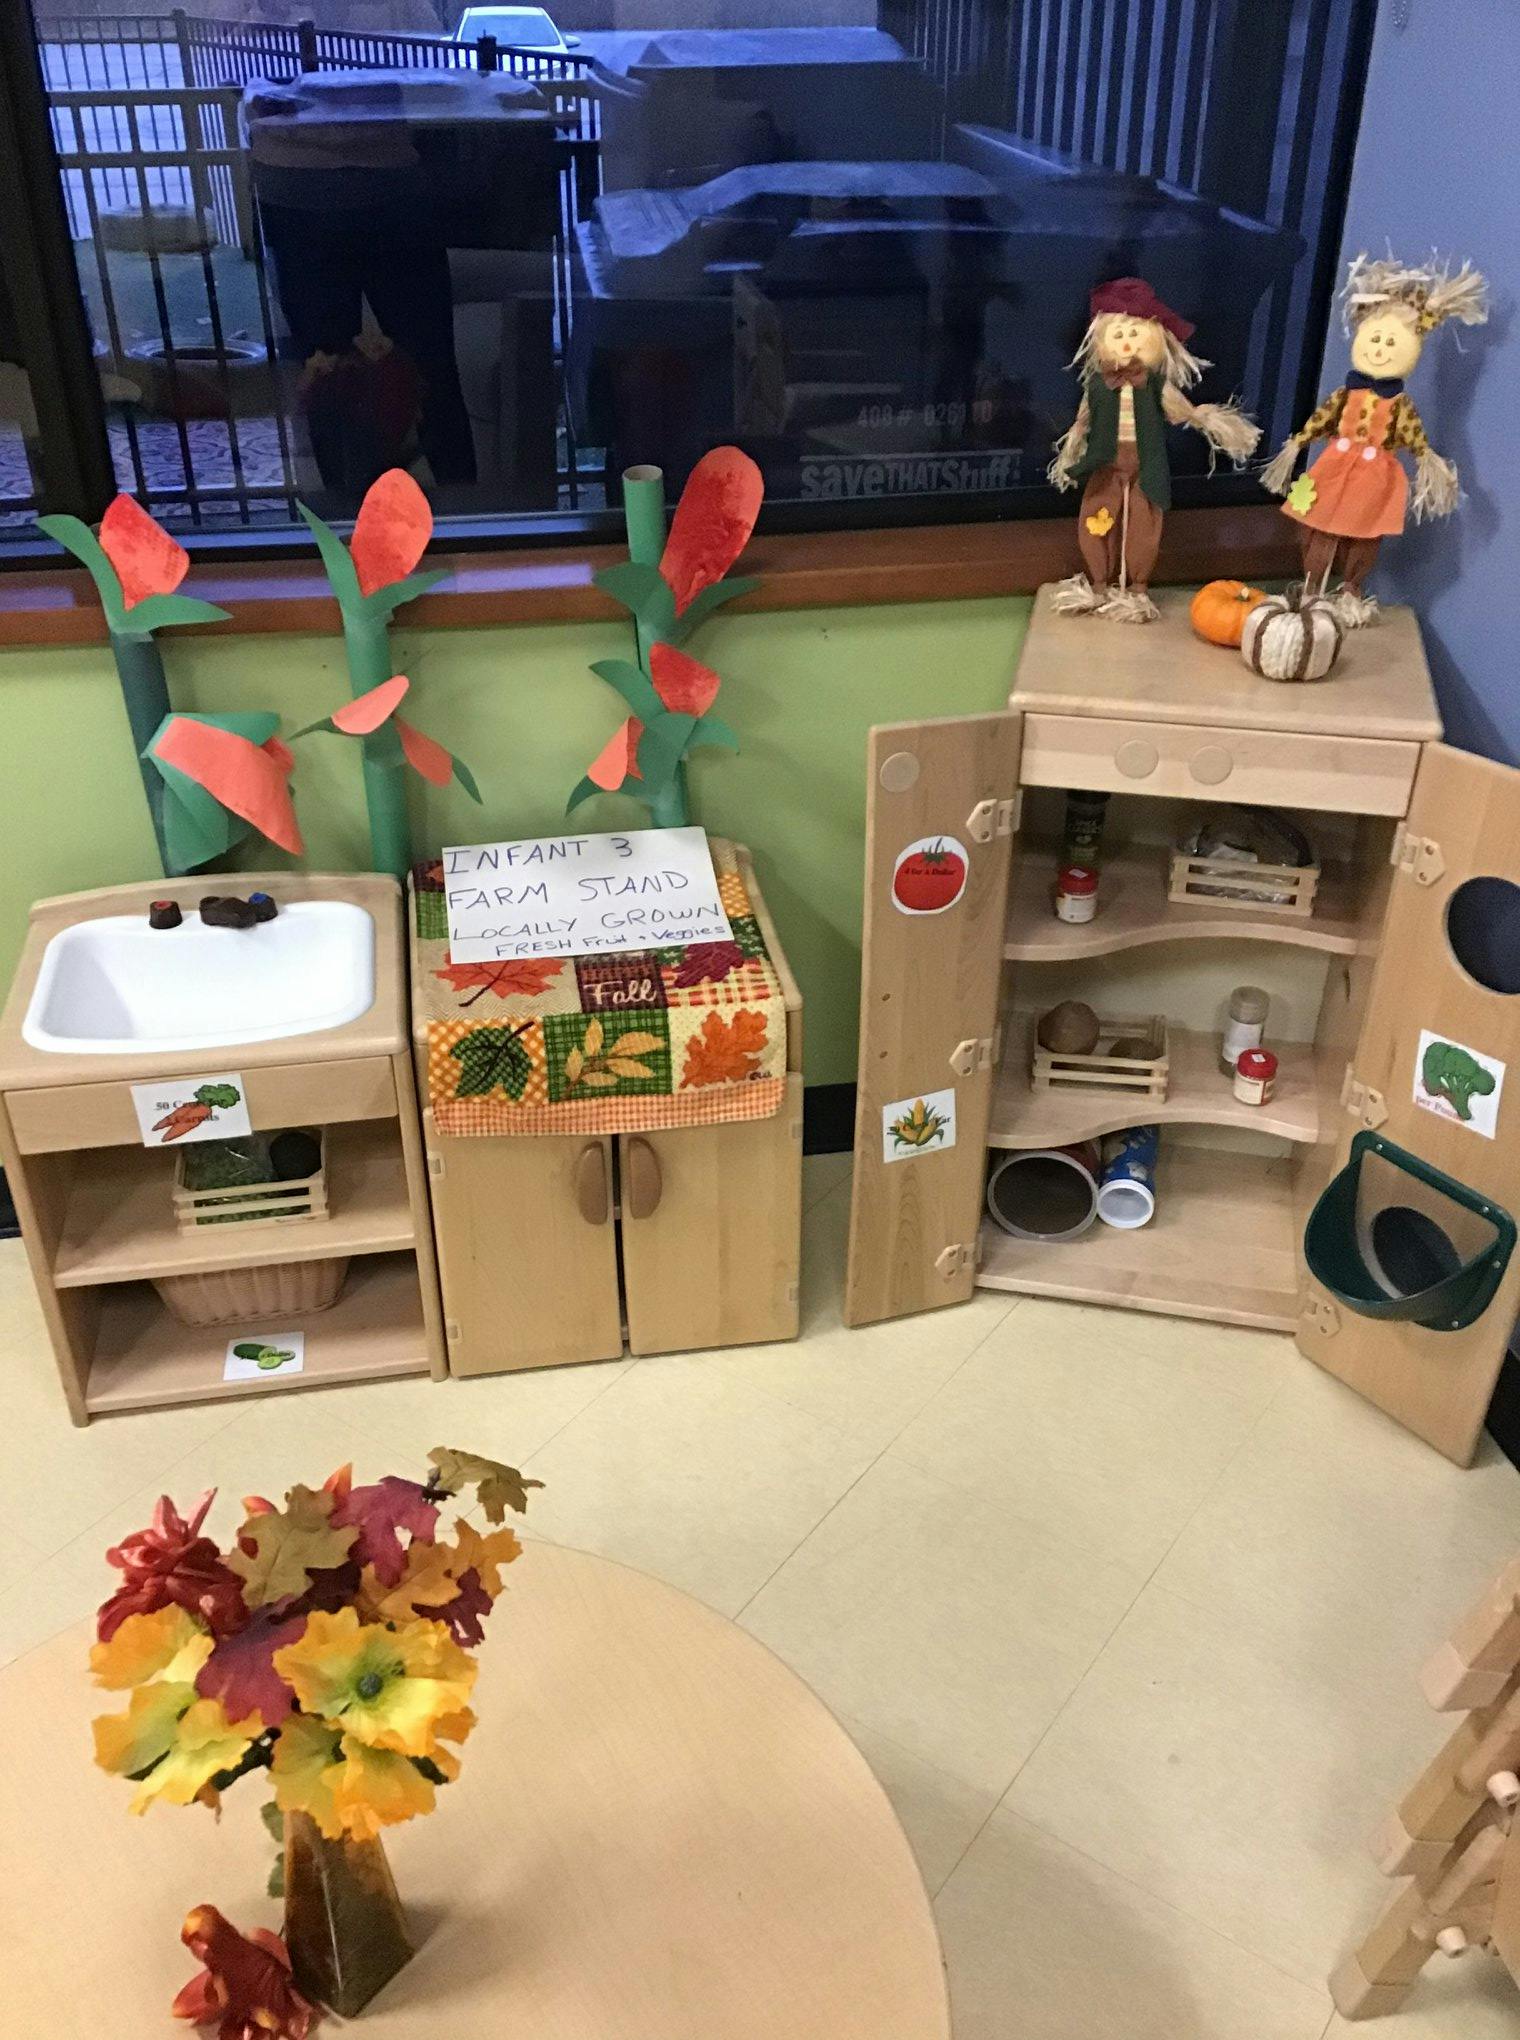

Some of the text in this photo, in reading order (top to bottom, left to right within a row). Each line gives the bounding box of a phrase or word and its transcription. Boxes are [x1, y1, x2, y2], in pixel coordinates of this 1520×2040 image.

[445, 838, 633, 874] INFANT 3
[449, 871, 688, 910] FARM STAND
[453, 903, 720, 941] LOCALLY GROWN
[495, 939, 572, 957] FRESH
[651, 925, 726, 941] Veggies
[583, 978, 657, 1005] Fall
